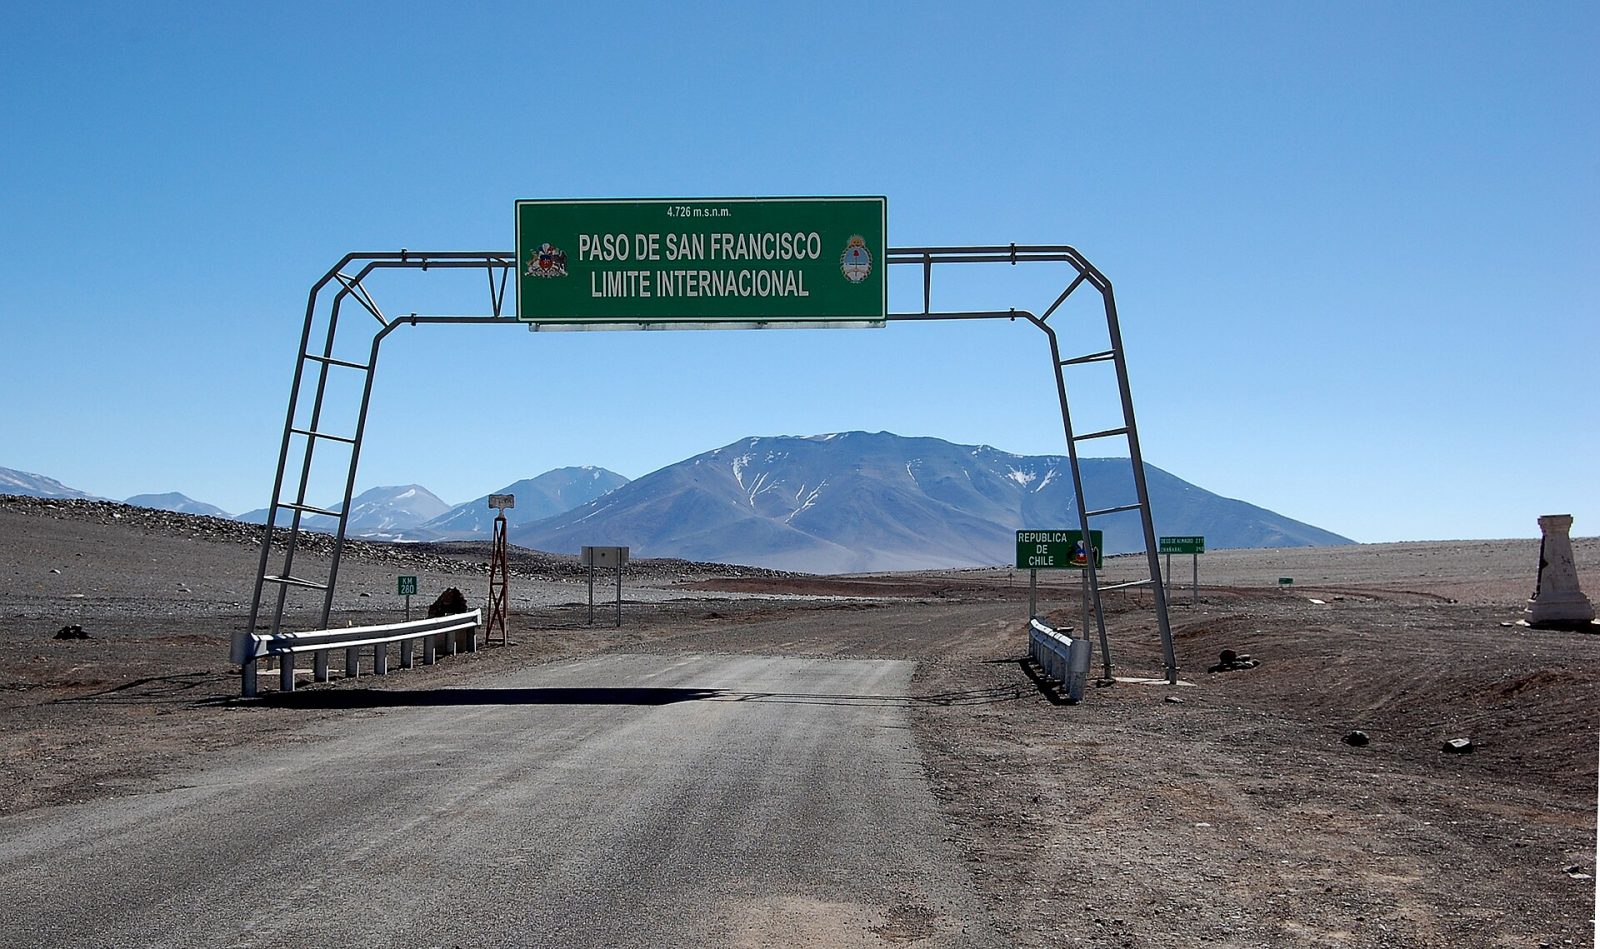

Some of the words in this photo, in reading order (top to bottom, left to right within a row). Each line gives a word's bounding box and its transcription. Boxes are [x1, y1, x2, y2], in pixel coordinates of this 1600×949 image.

[667, 206, 691, 217] 4.726
[693, 206, 732, 217] m.s.n.m.
[579, 233, 630, 261] PASO
[635, 233, 660, 261] DE
[666, 233, 704, 261] SAN
[711, 231, 821, 260] FRANCISCO
[591, 270, 651, 298] LIMITE
[656, 269, 809, 297] INTERNACIONAL
[1018, 532, 1068, 543] REPUBLICA
[1036, 544, 1048, 554] DE
[1028, 555, 1054, 566] CHILE
[401, 584, 414, 594] 280
